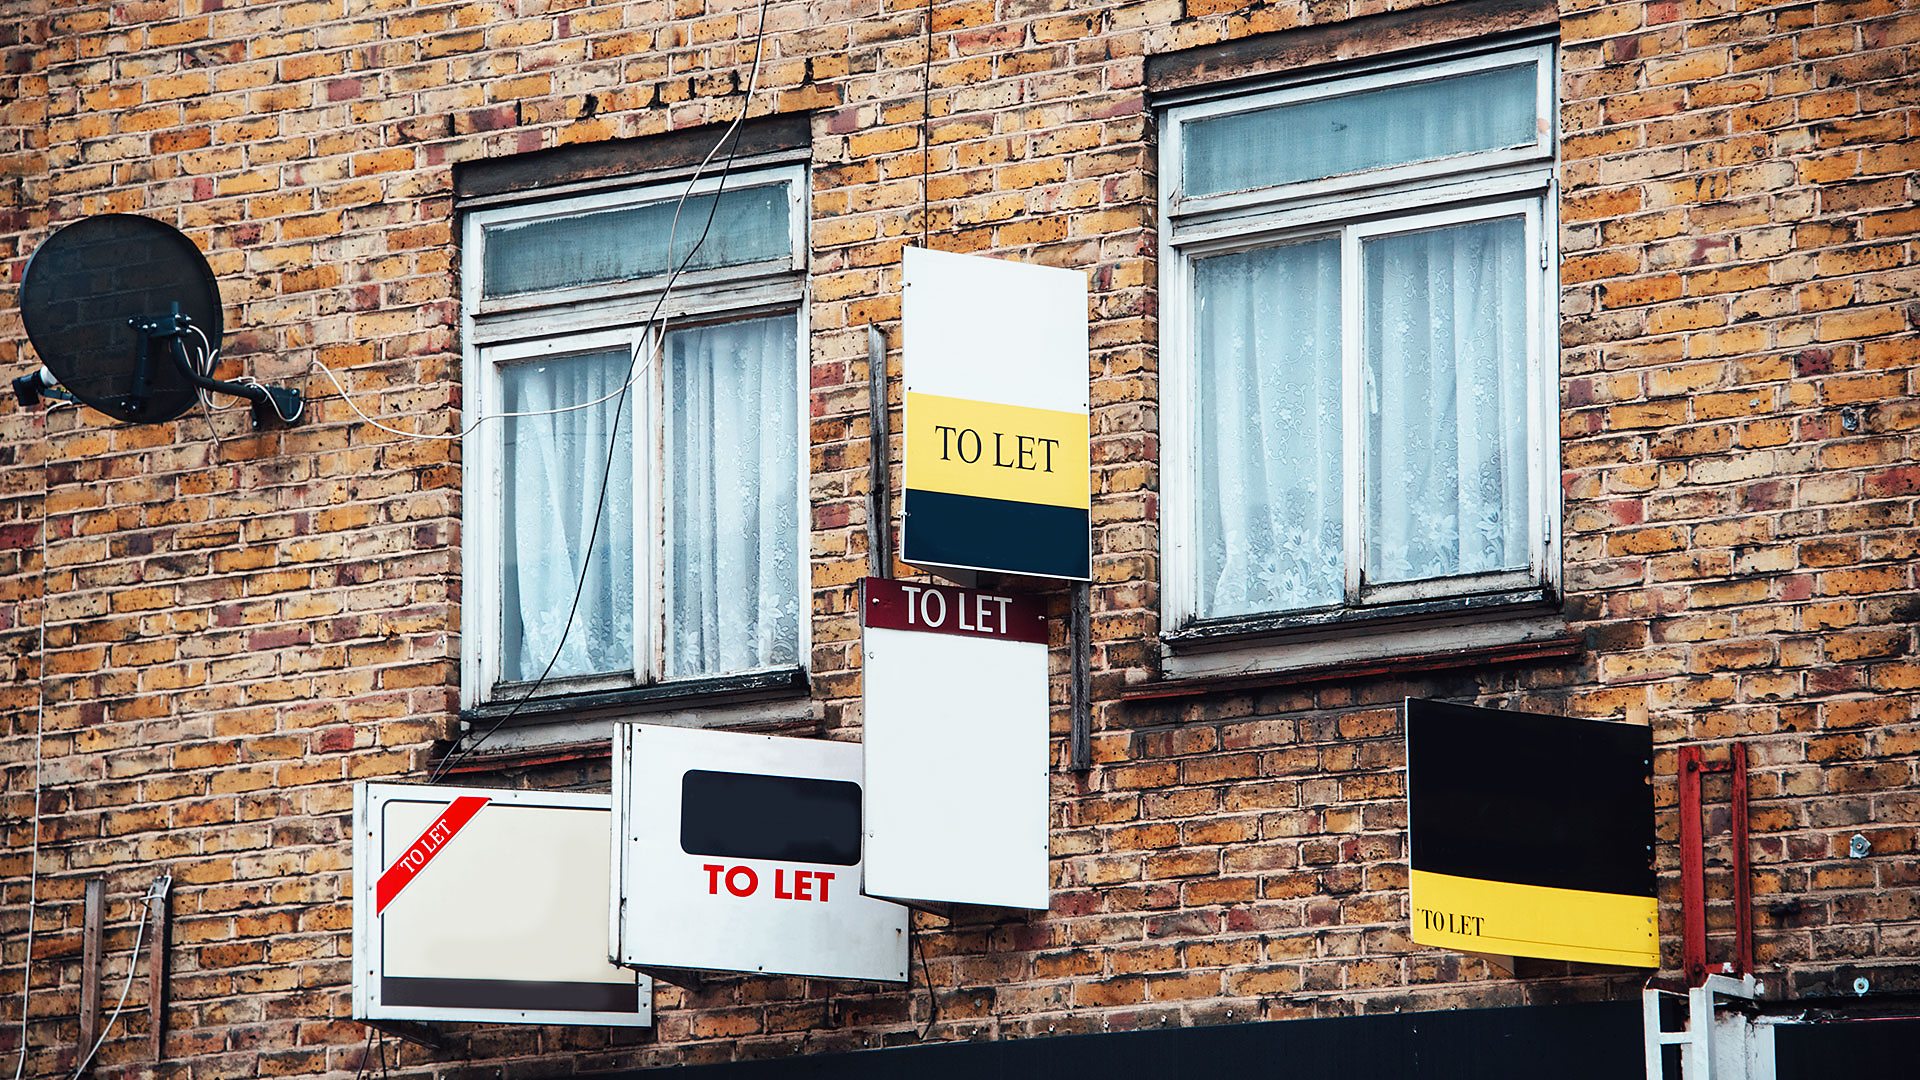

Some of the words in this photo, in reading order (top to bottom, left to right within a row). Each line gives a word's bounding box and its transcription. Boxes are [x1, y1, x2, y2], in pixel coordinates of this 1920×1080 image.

[935, 425, 982, 464] TO
[992, 432, 1060, 474] LET
[902, 585, 947, 628] TO
[958, 592, 1013, 634] LET
[399, 848, 425, 873] TO
[420, 818, 452, 854] LET
[703, 863, 759, 898] TO
[774, 868, 836, 903] LET
[1421, 909, 1445, 932] TO
[1449, 913, 1485, 937] LET
